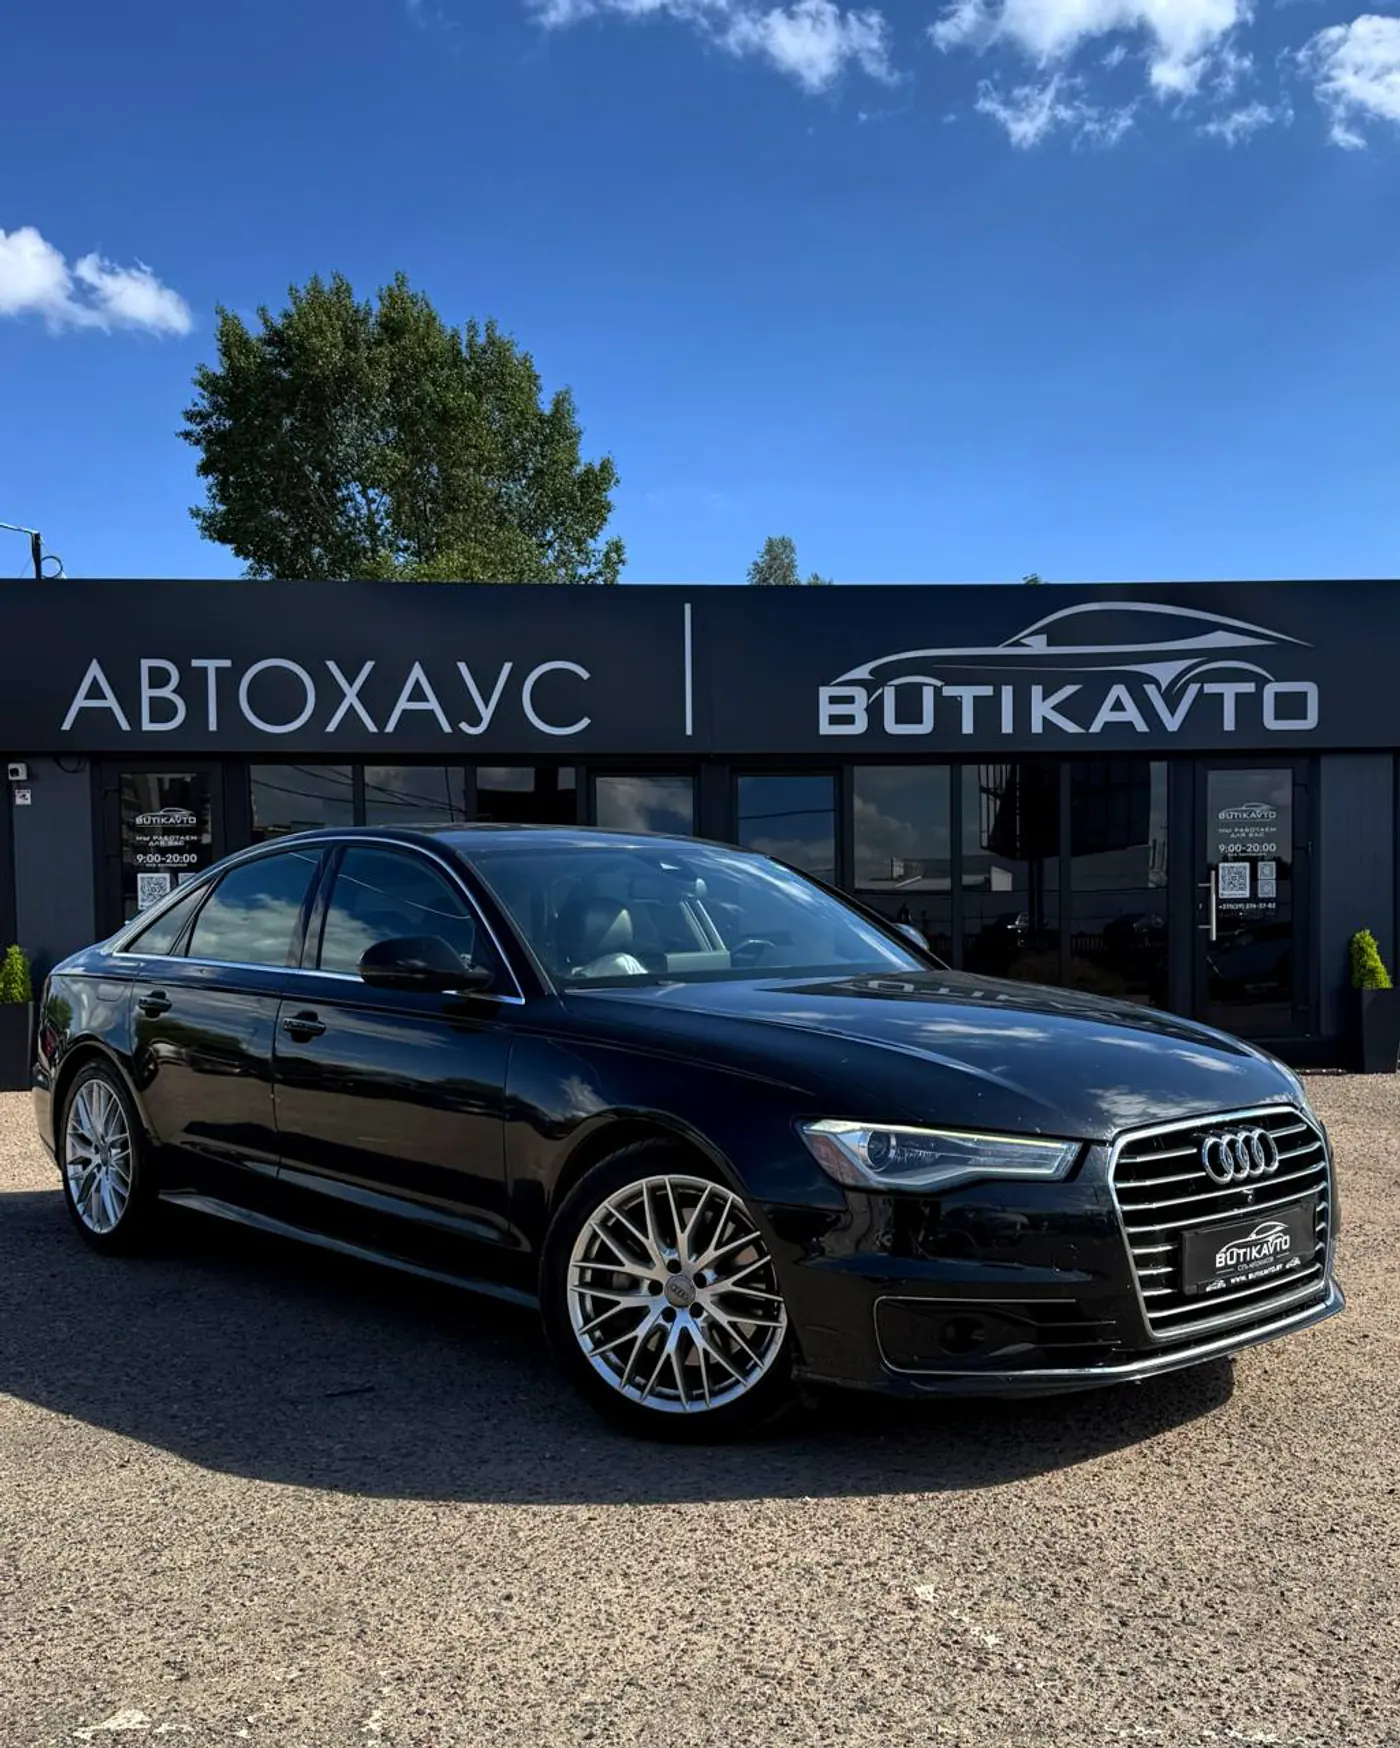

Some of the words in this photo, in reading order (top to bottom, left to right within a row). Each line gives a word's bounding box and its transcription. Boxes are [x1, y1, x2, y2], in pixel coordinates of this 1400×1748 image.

[61, 658, 591, 736] АВТОХАУС
[818, 681, 1319, 735] BUTIKAVTO
[135, 815, 196, 825] BUTIKAVTO
[1218, 811, 1276, 820] BUTIKAVTO
[1218, 843, 1277, 853] 9:00-20:00
[136, 854, 197, 863] 9:00-20:00
[1215, 1235, 1290, 1268] BUTIKAVTO
